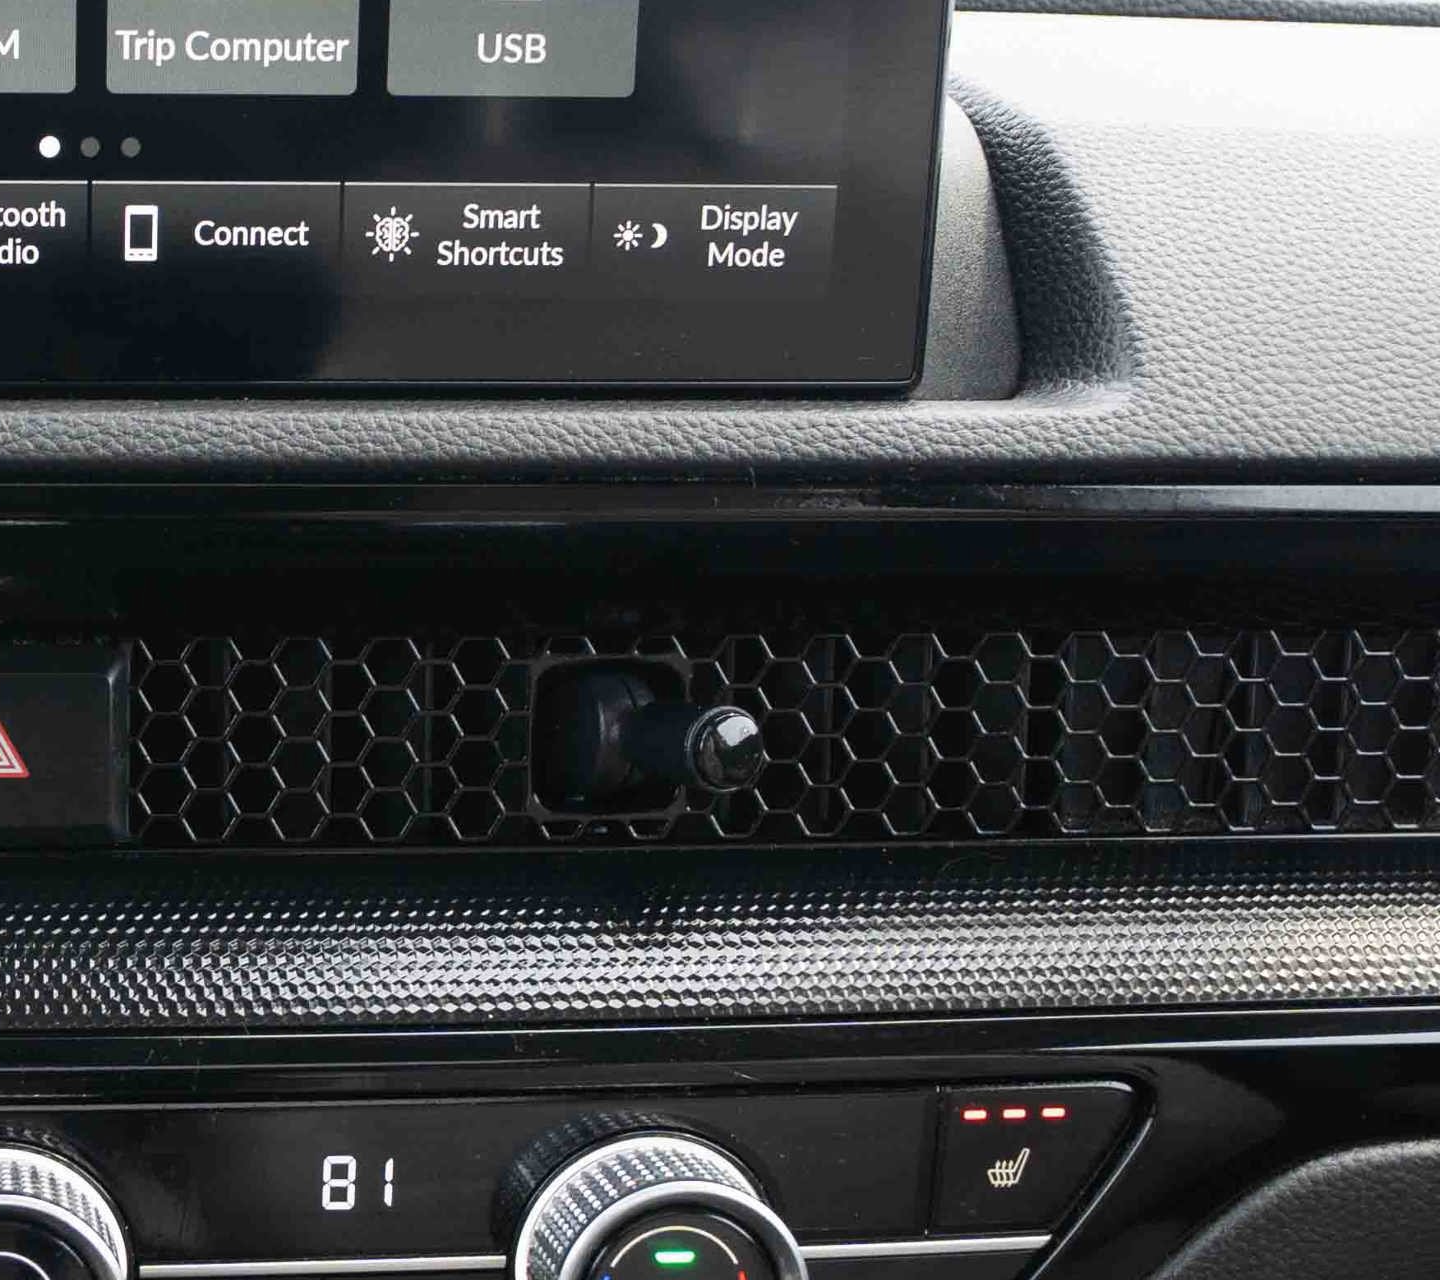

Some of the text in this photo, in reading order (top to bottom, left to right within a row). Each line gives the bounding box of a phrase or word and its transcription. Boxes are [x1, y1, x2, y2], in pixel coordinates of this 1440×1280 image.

[115, 30, 349, 68] Trip Computer
[477, 33, 547, 65] USB
[463, 202, 541, 232] Smart
[700, 204, 798, 238] Display
[193, 219, 309, 249] Connect
[437, 239, 563, 269] Shortcuts
[707, 240, 785, 270] Mode
[322, 1155, 395, 1211] 81
